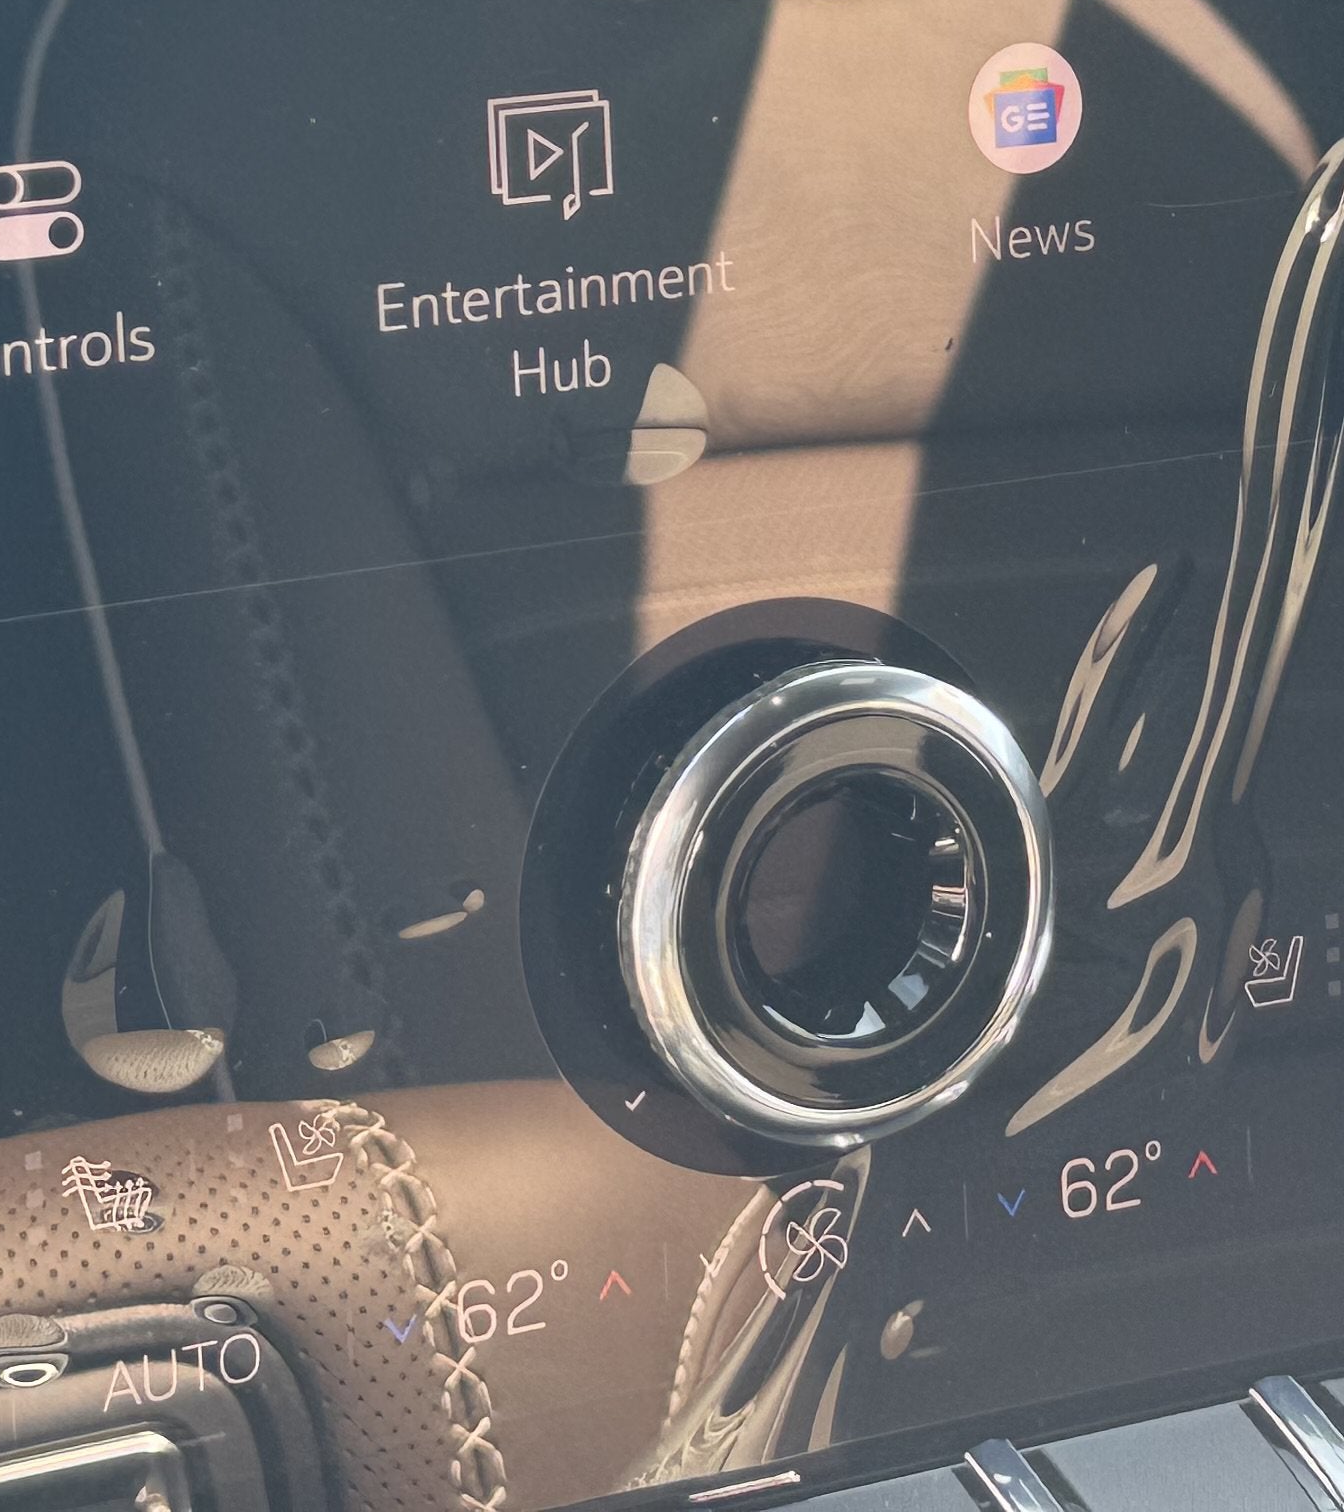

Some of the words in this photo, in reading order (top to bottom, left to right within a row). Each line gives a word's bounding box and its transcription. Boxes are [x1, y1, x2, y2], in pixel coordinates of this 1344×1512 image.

[968, 214, 1097, 265] News
[375, 249, 738, 334] Entertainment
[511, 338, 613, 399] Hub
[1059, 1139, 1162, 1220] 62°
[102, 1332, 262, 1413] AUTO
